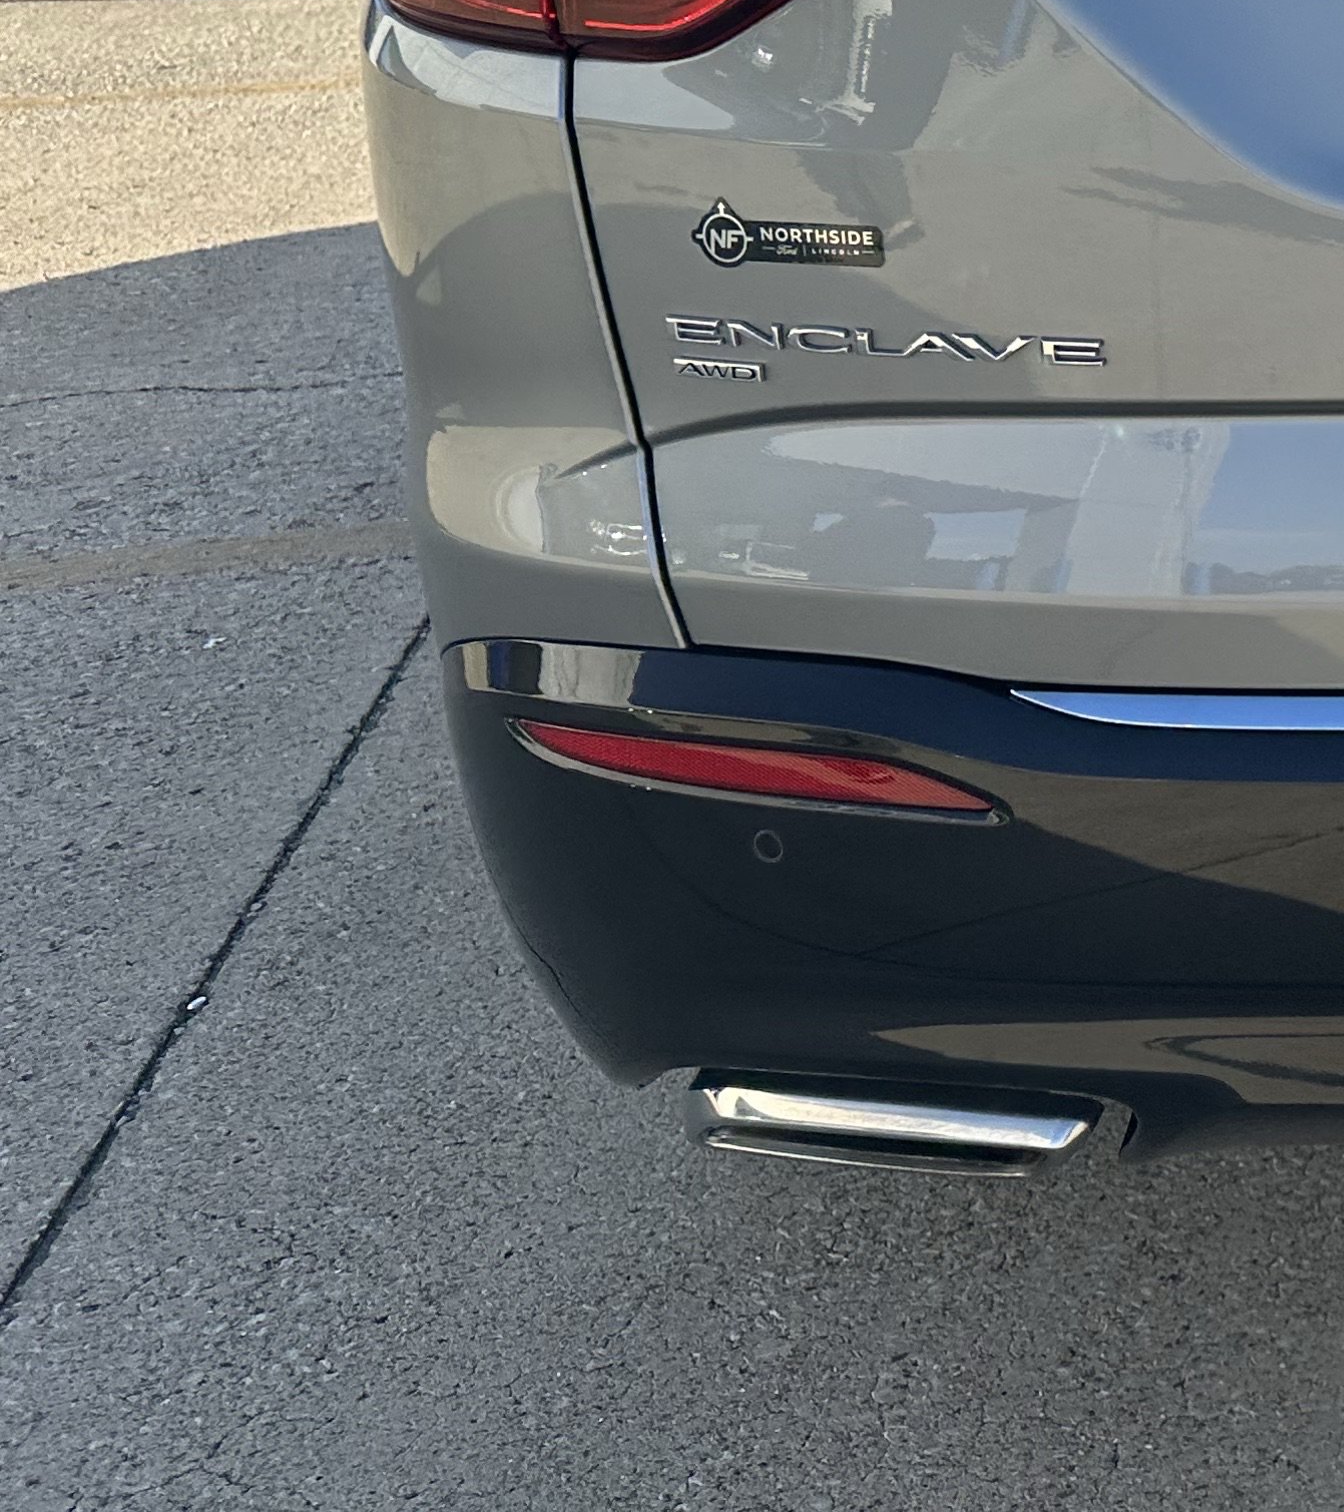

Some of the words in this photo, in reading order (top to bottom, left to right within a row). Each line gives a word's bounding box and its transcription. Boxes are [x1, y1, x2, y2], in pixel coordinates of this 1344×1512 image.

[709, 228, 746, 257] NF
[759, 226, 875, 246] NORTHSIDE
[811, 247, 860, 256] LINCOLN
[665, 313, 1107, 367] ENCLAVE
[677, 362, 758, 381] AWD
